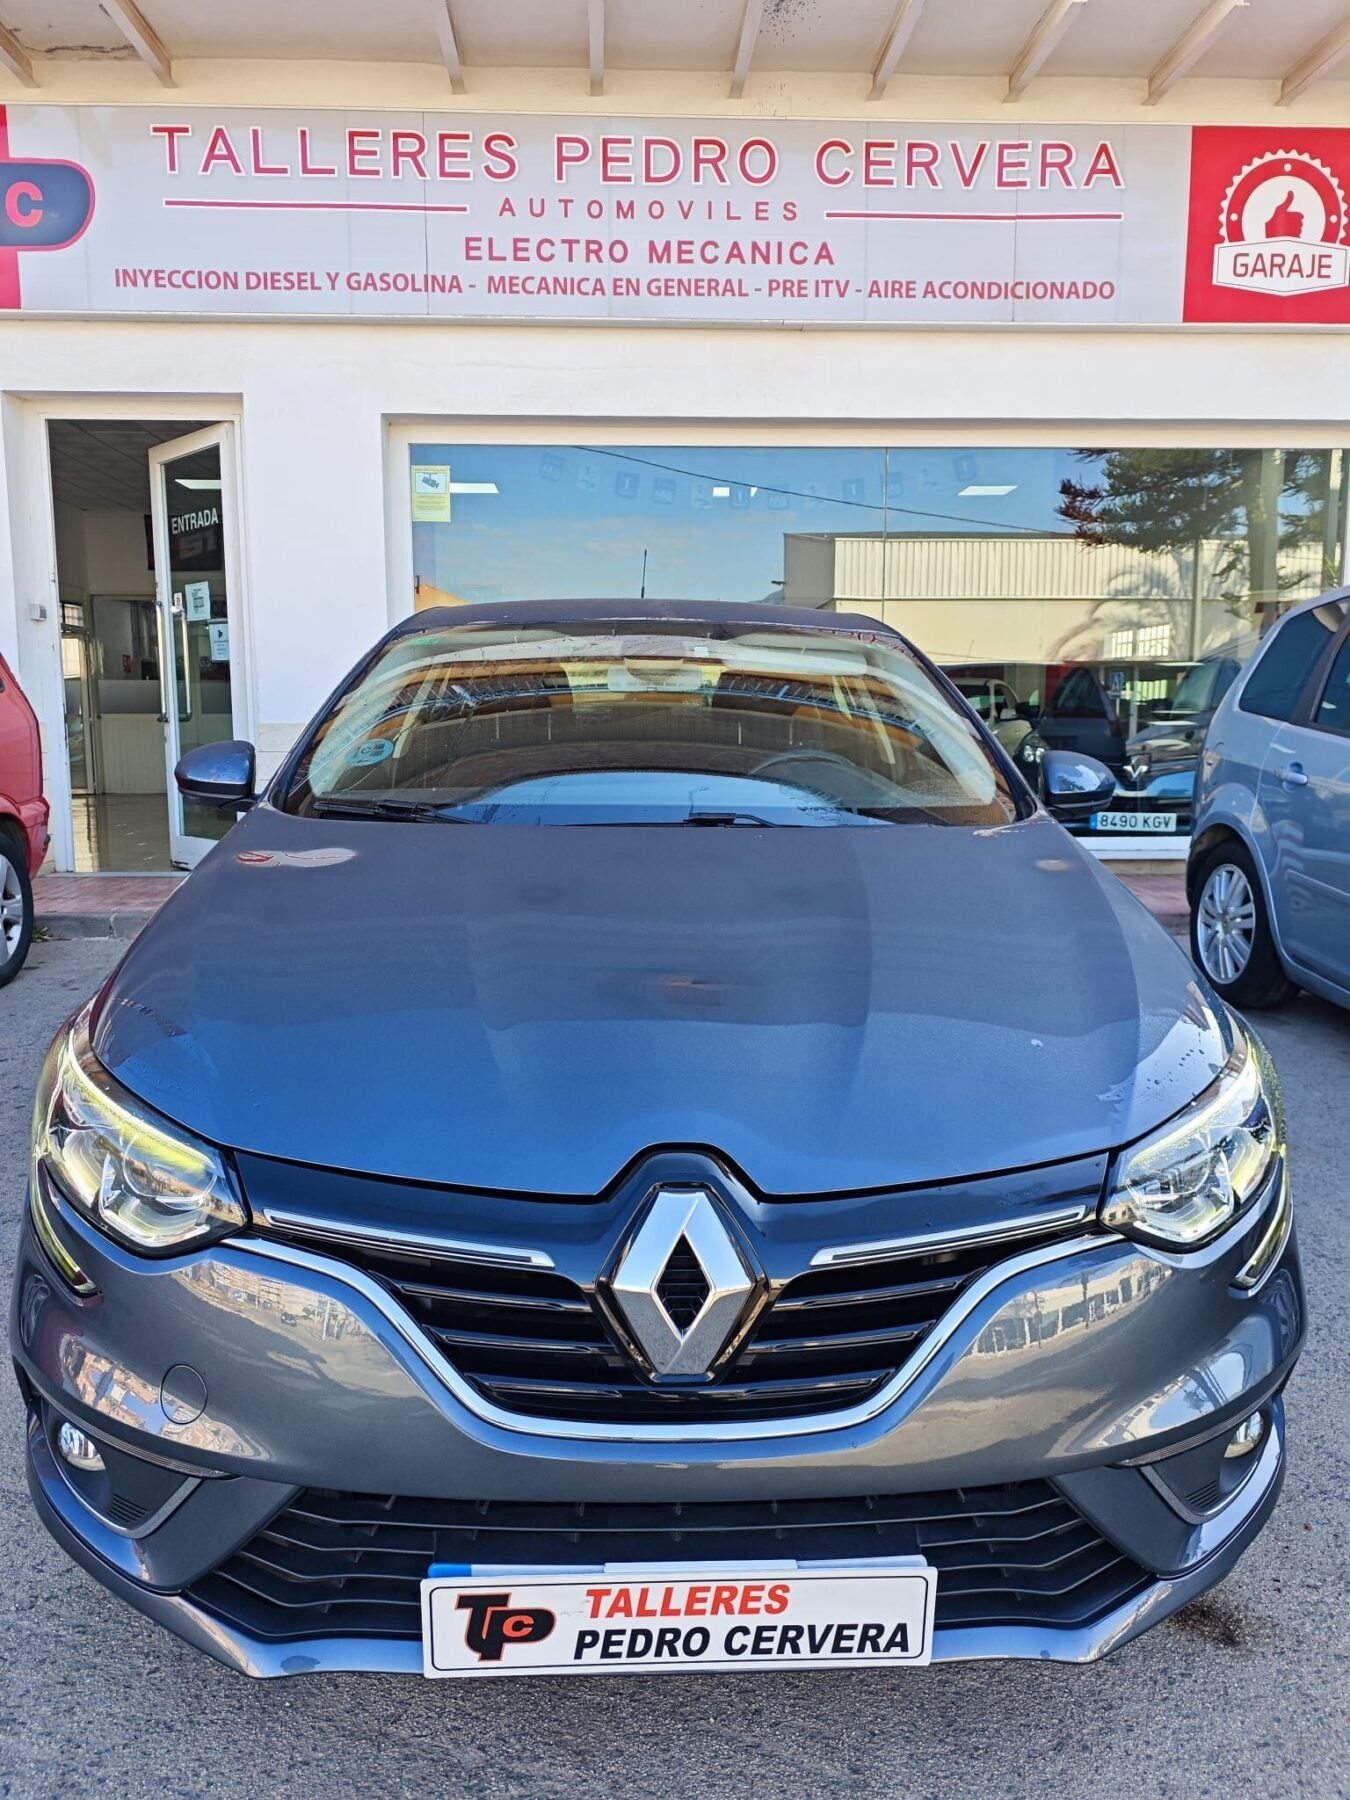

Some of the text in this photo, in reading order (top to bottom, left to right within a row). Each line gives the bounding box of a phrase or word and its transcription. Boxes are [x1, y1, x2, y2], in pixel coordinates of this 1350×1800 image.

[150, 124, 1123, 190] TALLERES PEDRO CERVERA
[499, 196, 799, 222] AUTOMOVILES
[464, 235, 835, 267] ELECTRO MECANICA
[1232, 252, 1333, 279] GARAJE
[114, 268, 239, 290] INYECCION
[245, 271, 322, 291] DIESEL
[326, 272, 340, 291] Y
[346, 271, 464, 293] GASOLINA
[487, 274, 607, 296] MECANICA
[612, 277, 641, 297] EN
[646, 277, 750, 298] GENERAL
[767, 278, 808, 299] PRE
[814, 279, 851, 299] ITV
[867, 279, 917, 299] AIRE
[922, 279, 1116, 301] ACONDICIONADO
[171, 508, 218, 535] ENTRADA
[1100, 814, 1172, 829] 8490 KGV
[585, 1584, 791, 1619] TALLERES
[573, 1622, 910, 1660] PEDRO CERVERA
